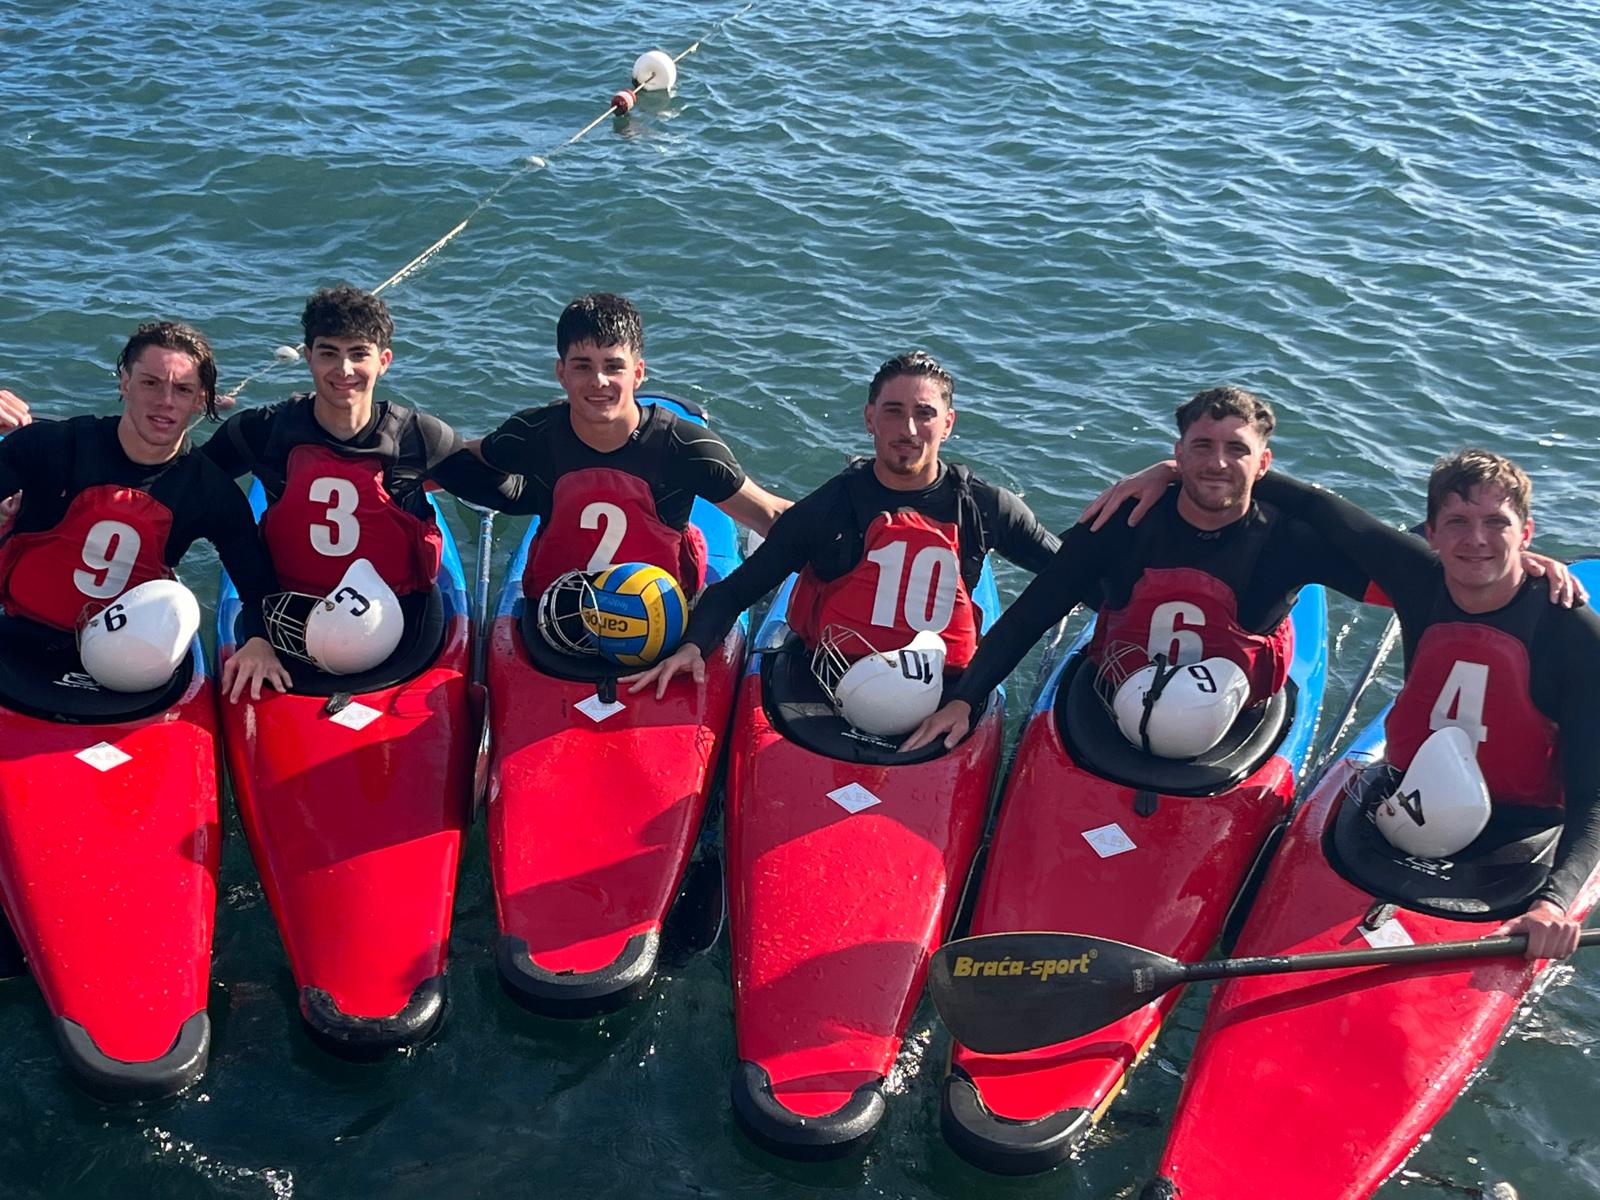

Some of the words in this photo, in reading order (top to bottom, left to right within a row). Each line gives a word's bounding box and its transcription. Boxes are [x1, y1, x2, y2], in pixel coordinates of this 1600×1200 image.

[309, 477, 360, 556] 3
[580, 502, 627, 576] 2
[73, 520, 141, 599] 9
[867, 540, 959, 633] 10
[335, 587, 370, 617] 3
[1147, 601, 1206, 666] 6
[1429, 660, 1489, 757] 4
[1397, 789, 1425, 827] 4
